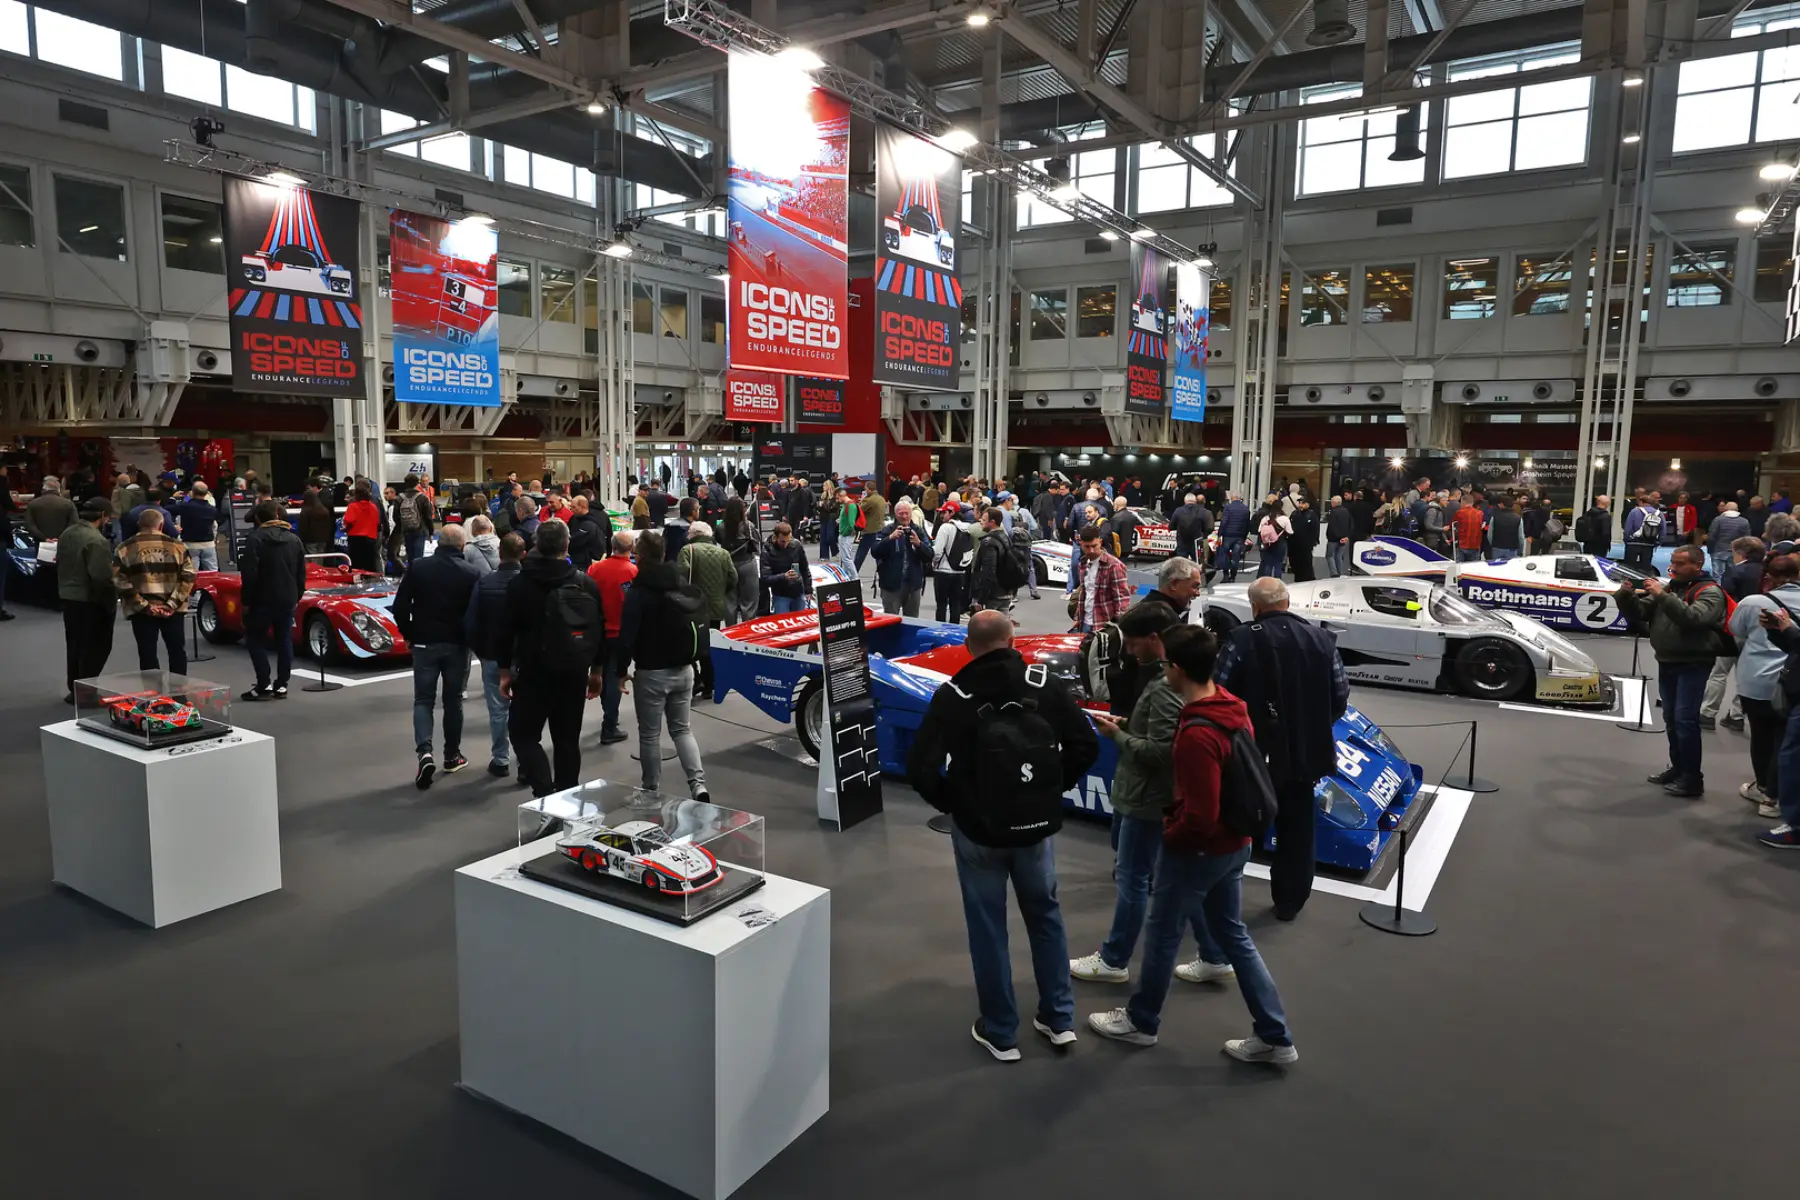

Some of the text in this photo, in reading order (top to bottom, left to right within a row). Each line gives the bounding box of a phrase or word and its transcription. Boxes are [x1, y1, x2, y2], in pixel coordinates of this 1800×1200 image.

[451, 281, 460, 296] 3
[741, 280, 835, 322] ICONS OF
[747, 312, 841, 349] SPEED
[881, 310, 944, 343] ICONS
[242, 332, 350, 359] ICONS OF
[885, 336, 953, 367] SPEED
[250, 352, 357, 378] SPEED
[403, 348, 481, 371] ICONS
[409, 366, 493, 389] SPEED
[1128, 364, 1159, 385] ICONS
[730, 381, 772, 396] ICONS
[801, 387, 837, 401] ICONS
[1130, 381, 1162, 400] SPEED
[1175, 389, 1202, 407] SPEED
[733, 394, 779, 409] SPEED
[802, 399, 842, 413] SPEED
[1468, 586, 1573, 608] Rothmans
[1586, 596, 1608, 623] 2
[750, 621, 779, 634] GTP
[1540, 691, 1583, 699] GOODYEAR
[1367, 765, 1402, 811] NISSAN
